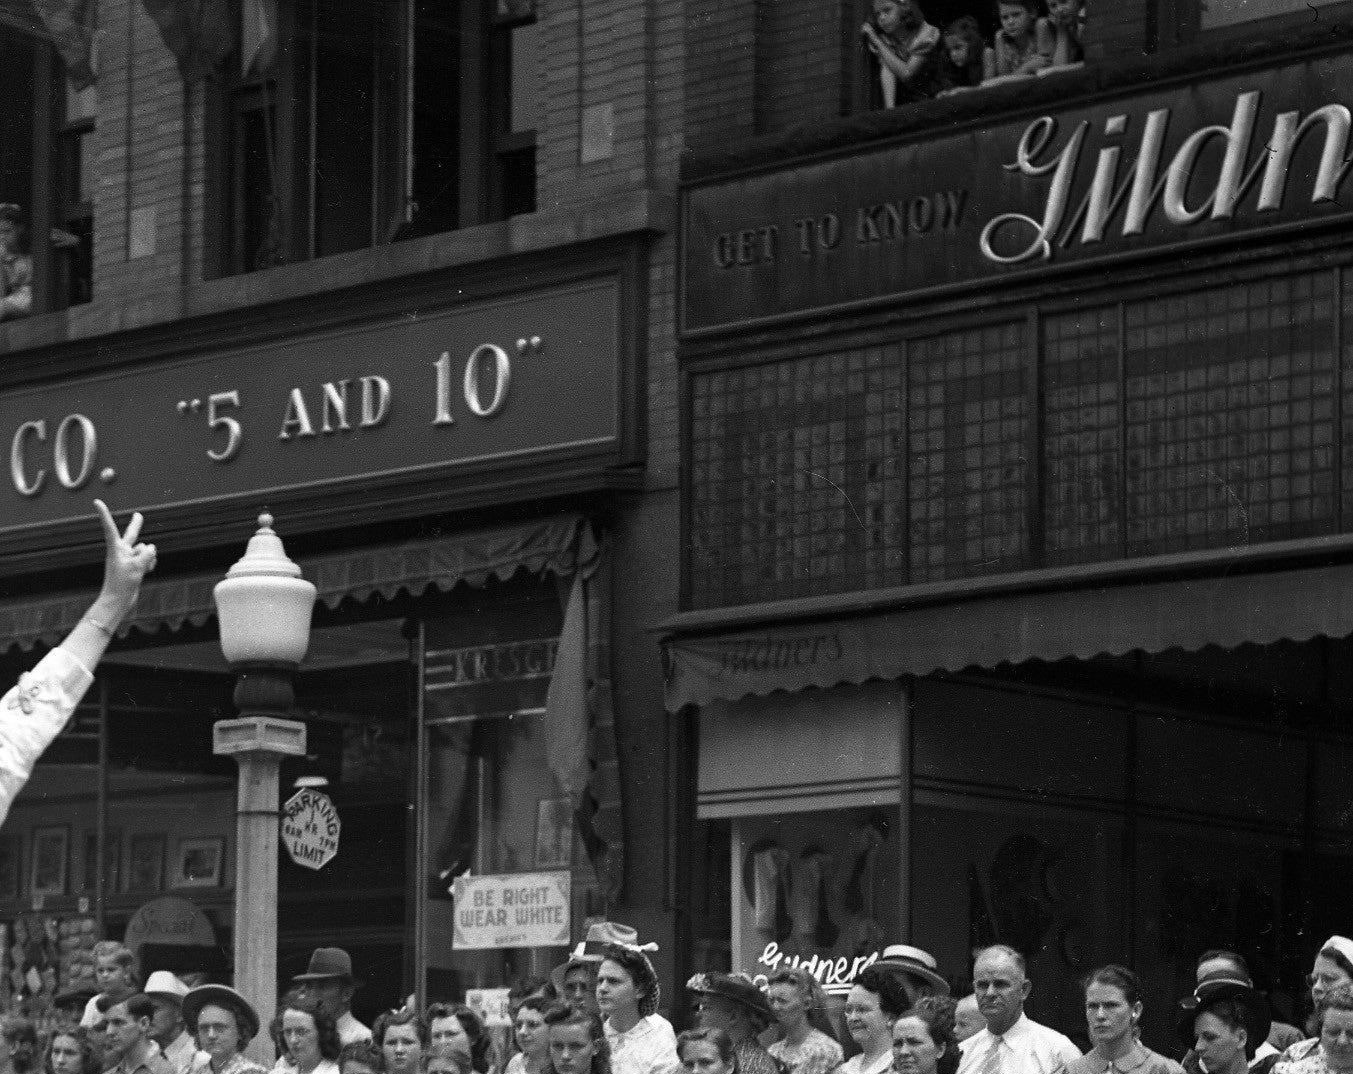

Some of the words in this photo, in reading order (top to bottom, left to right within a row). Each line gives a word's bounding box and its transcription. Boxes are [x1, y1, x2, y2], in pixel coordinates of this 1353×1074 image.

[713, 223, 778, 269] GET
[797, 213, 841, 258] TO
[857, 189, 969, 246] KNOW
[11, 412, 116, 496] CO.
[280, 374, 392, 440] AND
[288, 793, 338, 836] PARKING
[293, 840, 325, 863] LIMIT
[472, 888, 494, 907] BE
[503, 886, 549, 906] RIGHT
[459, 908, 507, 929] WEAR
[515, 905, 563, 926] WHITE
